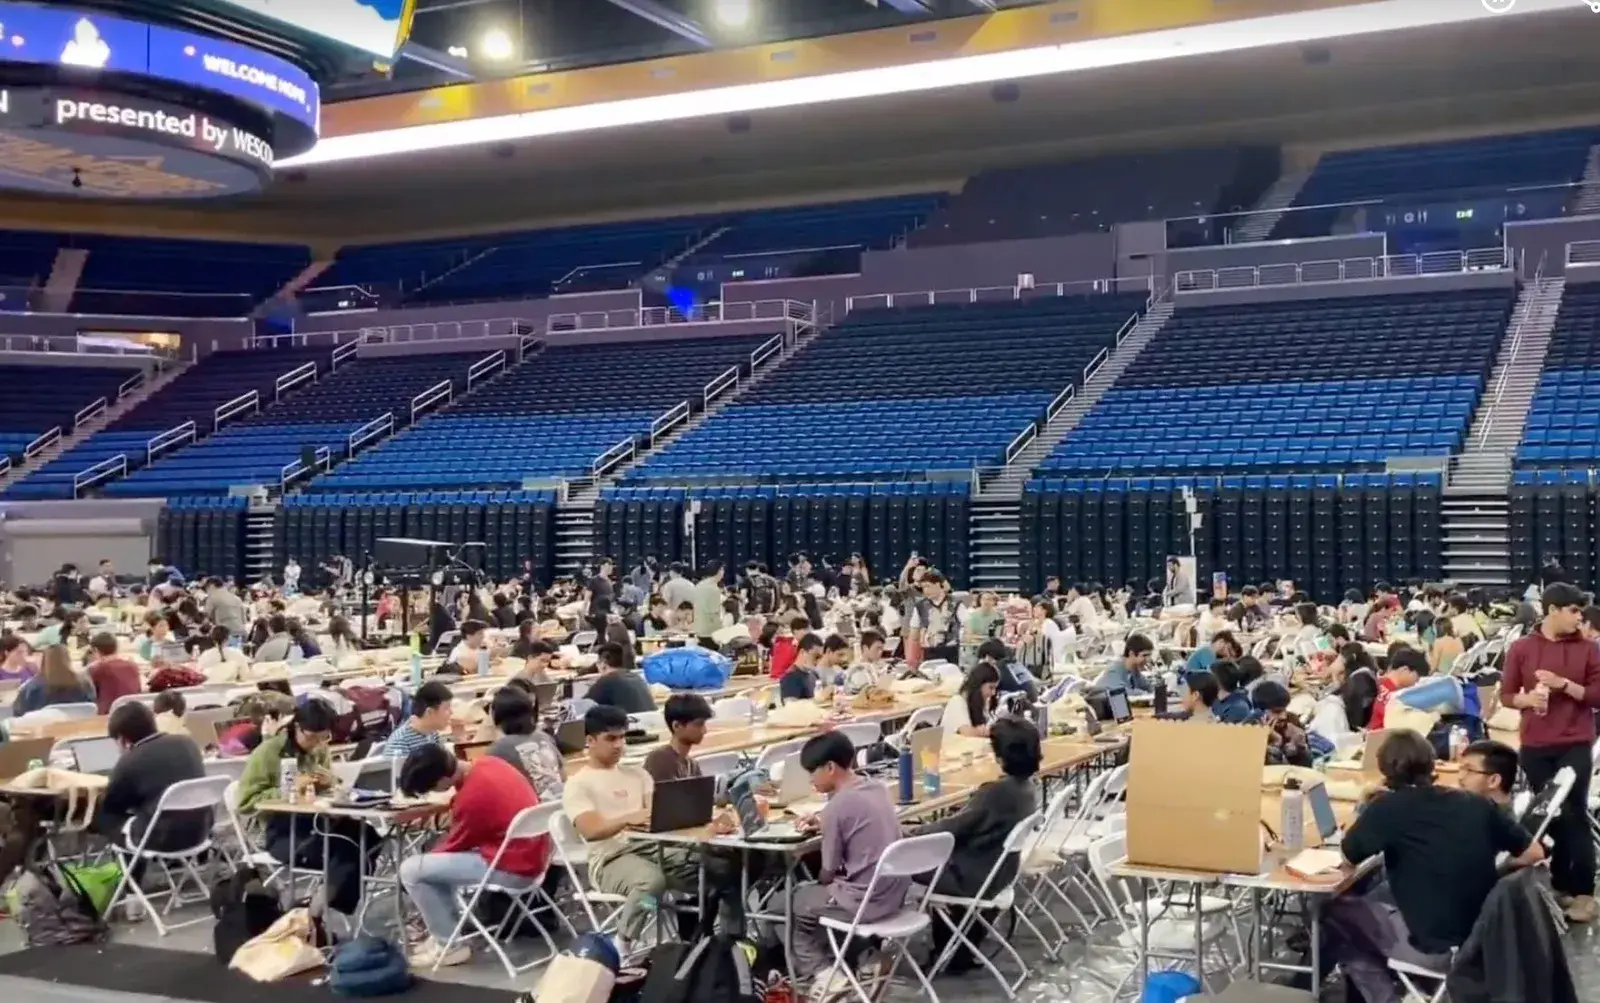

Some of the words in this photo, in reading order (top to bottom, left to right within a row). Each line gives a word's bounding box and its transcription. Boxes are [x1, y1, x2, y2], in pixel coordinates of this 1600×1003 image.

[203, 54, 278, 92] WELCOME
[56, 98, 196, 138] presented
[202, 116, 228, 151] by
